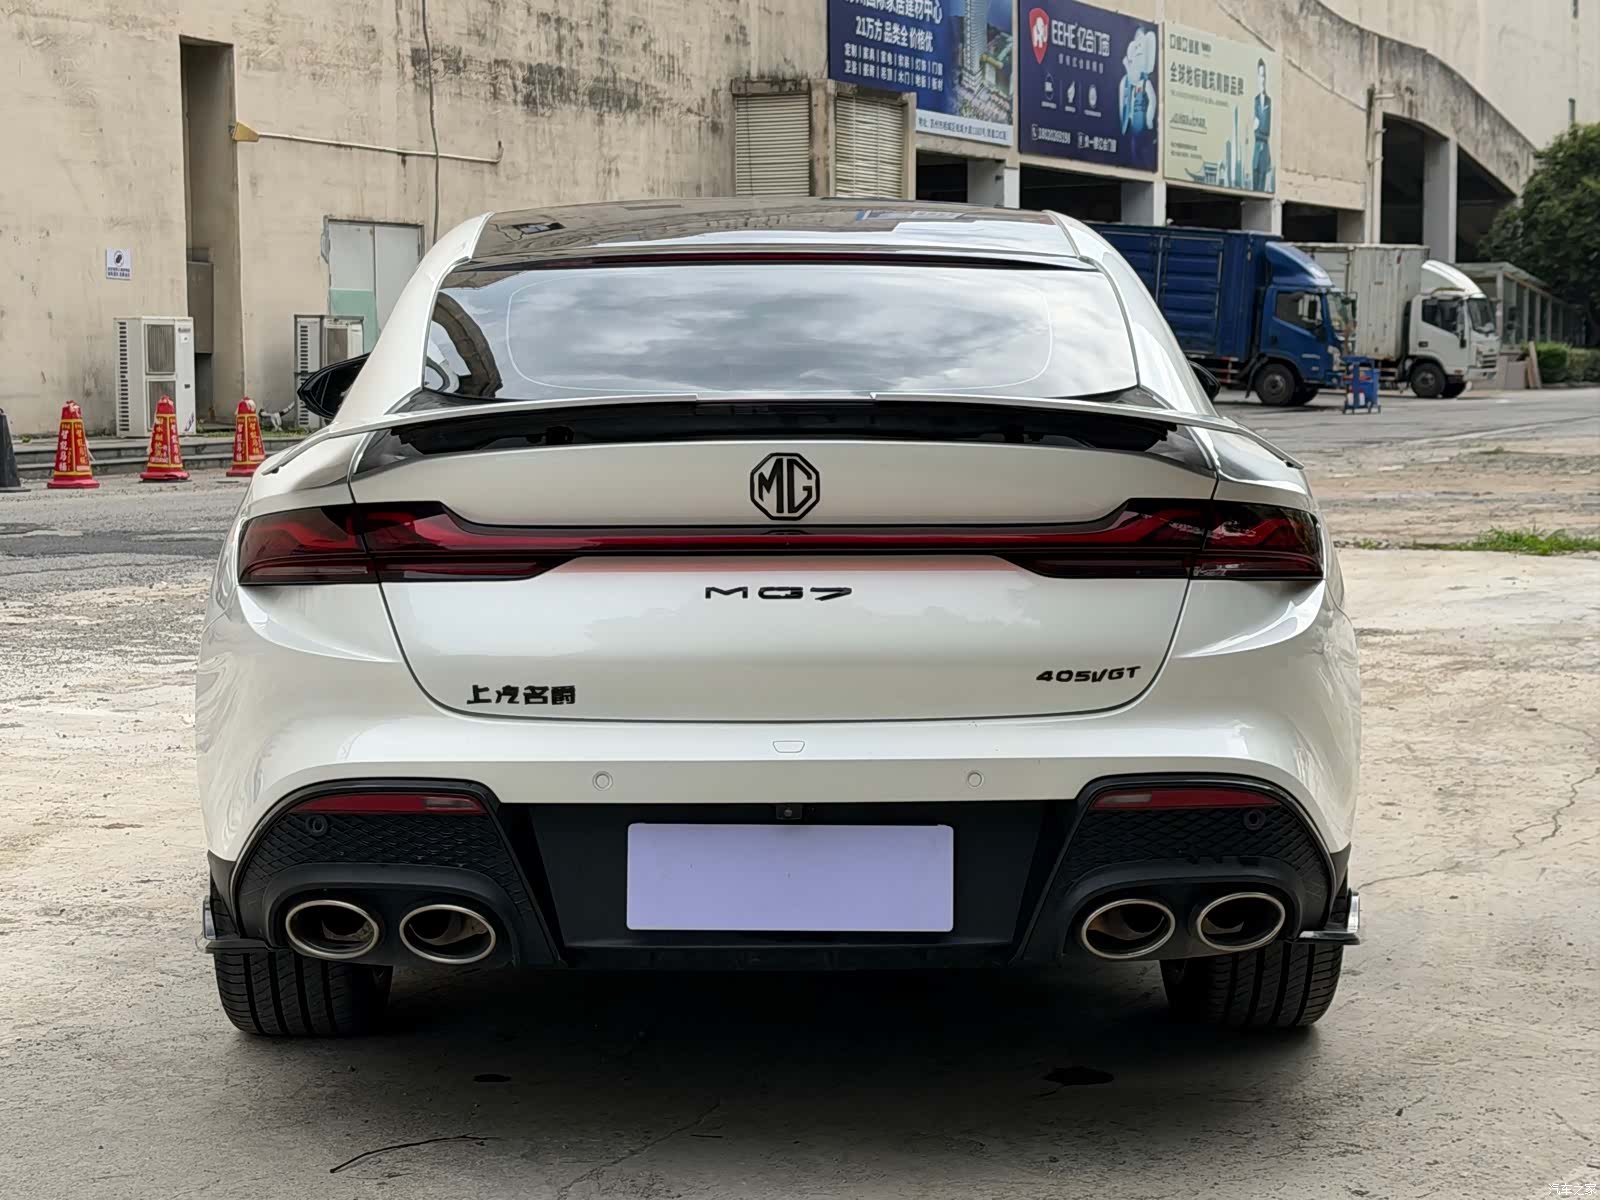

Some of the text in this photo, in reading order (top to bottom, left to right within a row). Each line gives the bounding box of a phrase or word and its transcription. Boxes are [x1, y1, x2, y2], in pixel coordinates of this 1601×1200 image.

[855, 16, 933, 53] 21万方 品类全 价格优
[757, 457, 813, 514] MG
[704, 586, 853, 601] MG7
[1036, 665, 1141, 683] 405VGT
[466, 684, 576, 706] 上汽名爵
